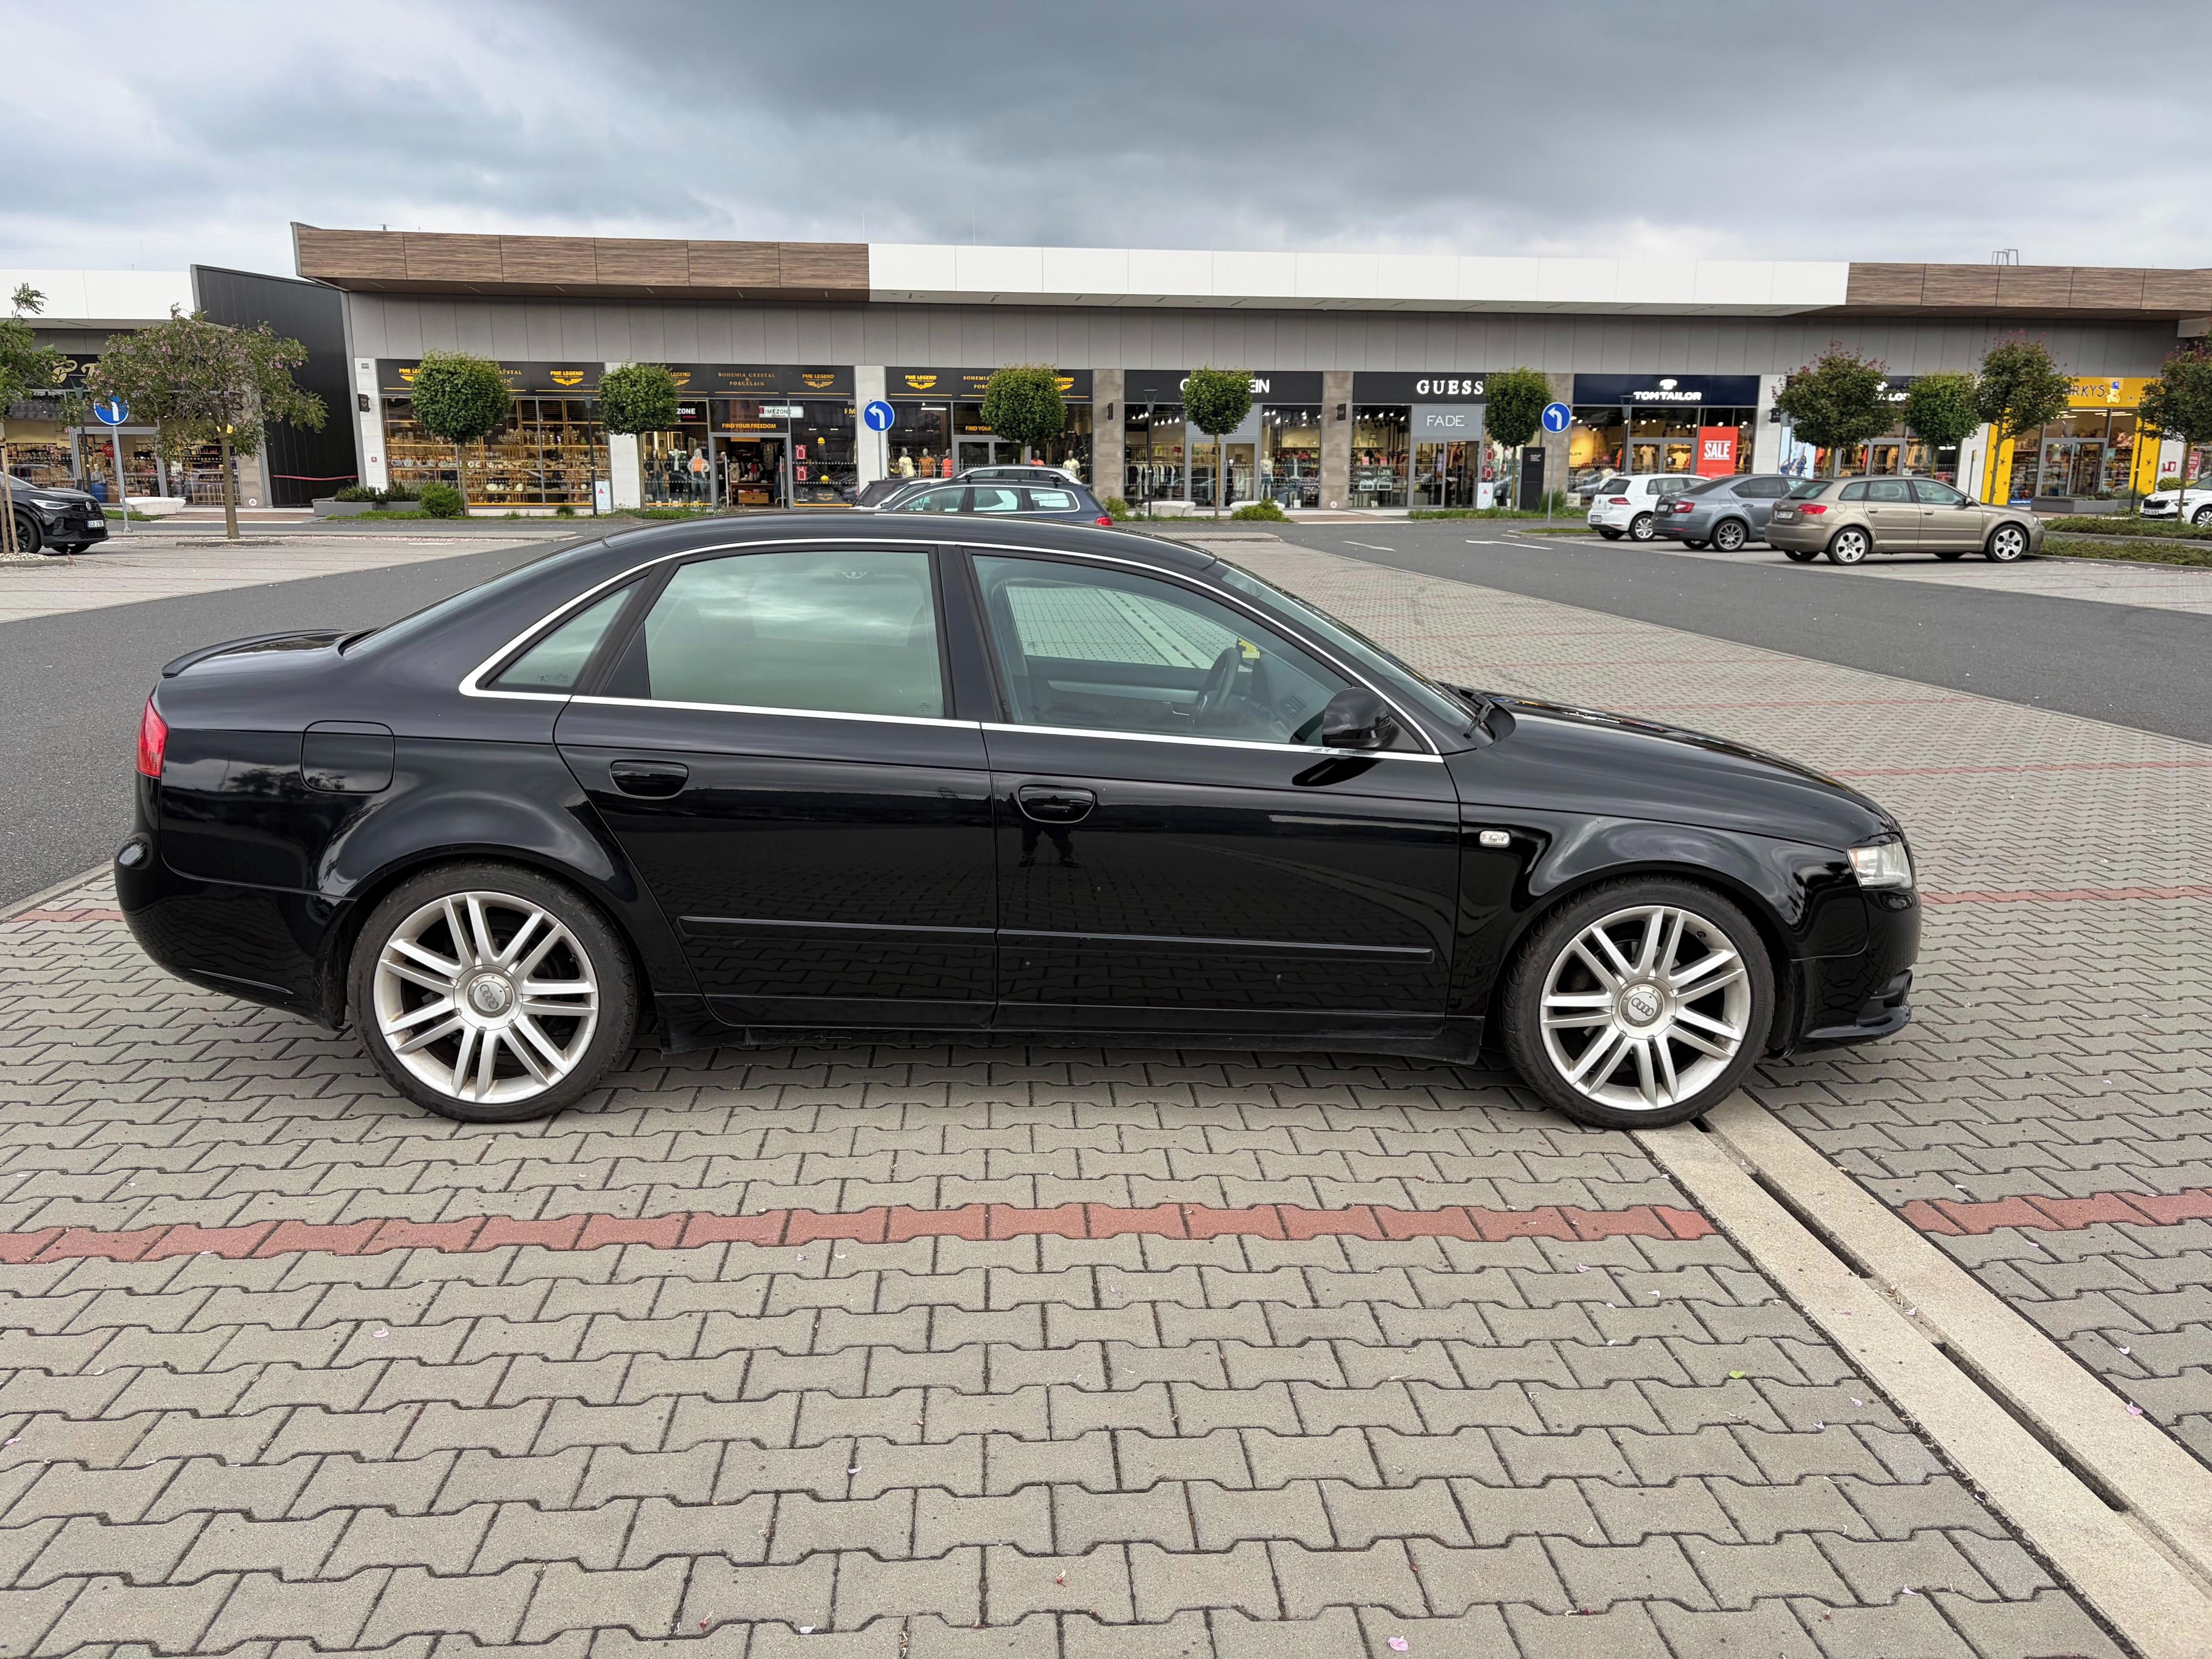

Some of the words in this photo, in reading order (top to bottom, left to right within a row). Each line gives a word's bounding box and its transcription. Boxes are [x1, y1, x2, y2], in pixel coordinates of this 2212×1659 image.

[1248, 379, 1270, 393] EIN
[1416, 380, 1484, 395] GUESS
[2072, 385, 2105, 397] RKYS
[1633, 391, 1660, 400] TOM
[1660, 392, 1702, 400] TAILOR
[1427, 415, 1465, 427] FADE
[1704, 443, 1731, 458] SALE
